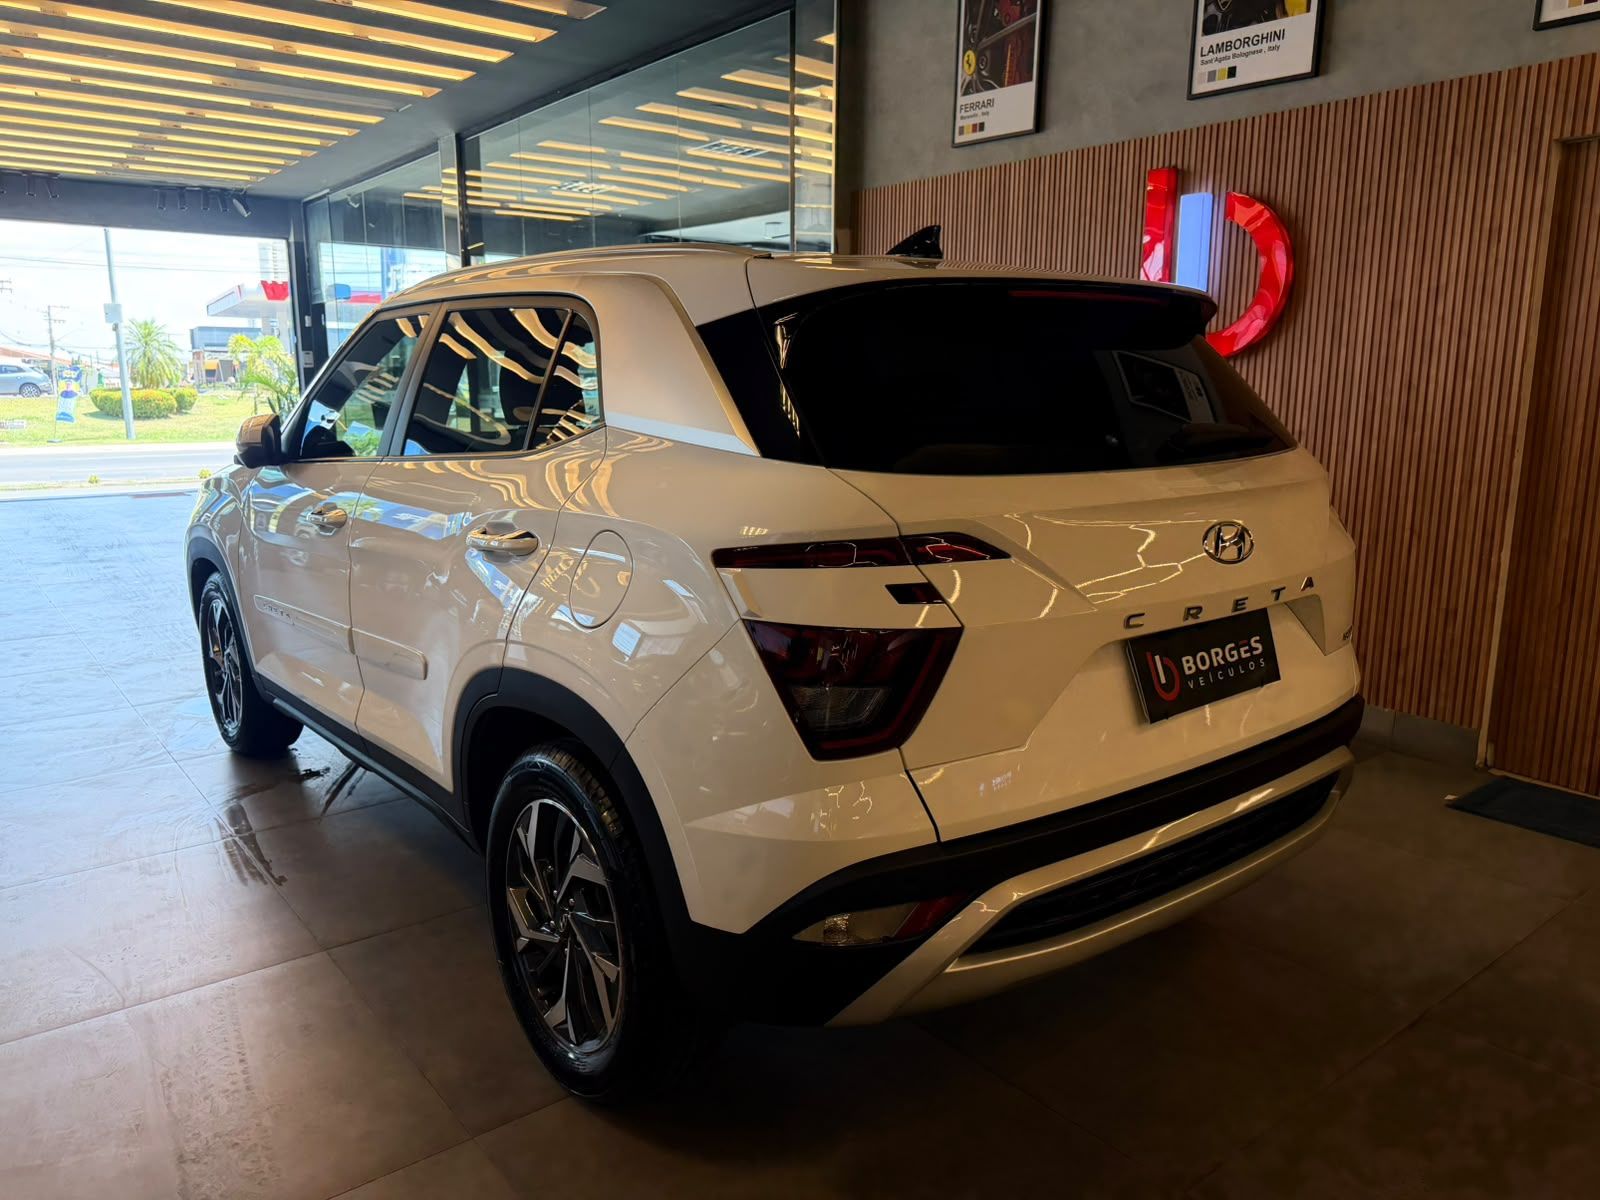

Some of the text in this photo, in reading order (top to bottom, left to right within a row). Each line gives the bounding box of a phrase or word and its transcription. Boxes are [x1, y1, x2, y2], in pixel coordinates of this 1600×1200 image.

[1200, 28, 1285, 57] LAMBORGHINI
[960, 98, 994, 113] FERRARI
[1123, 576, 1315, 630] CRETA
[1181, 636, 1263, 675] BORGES
